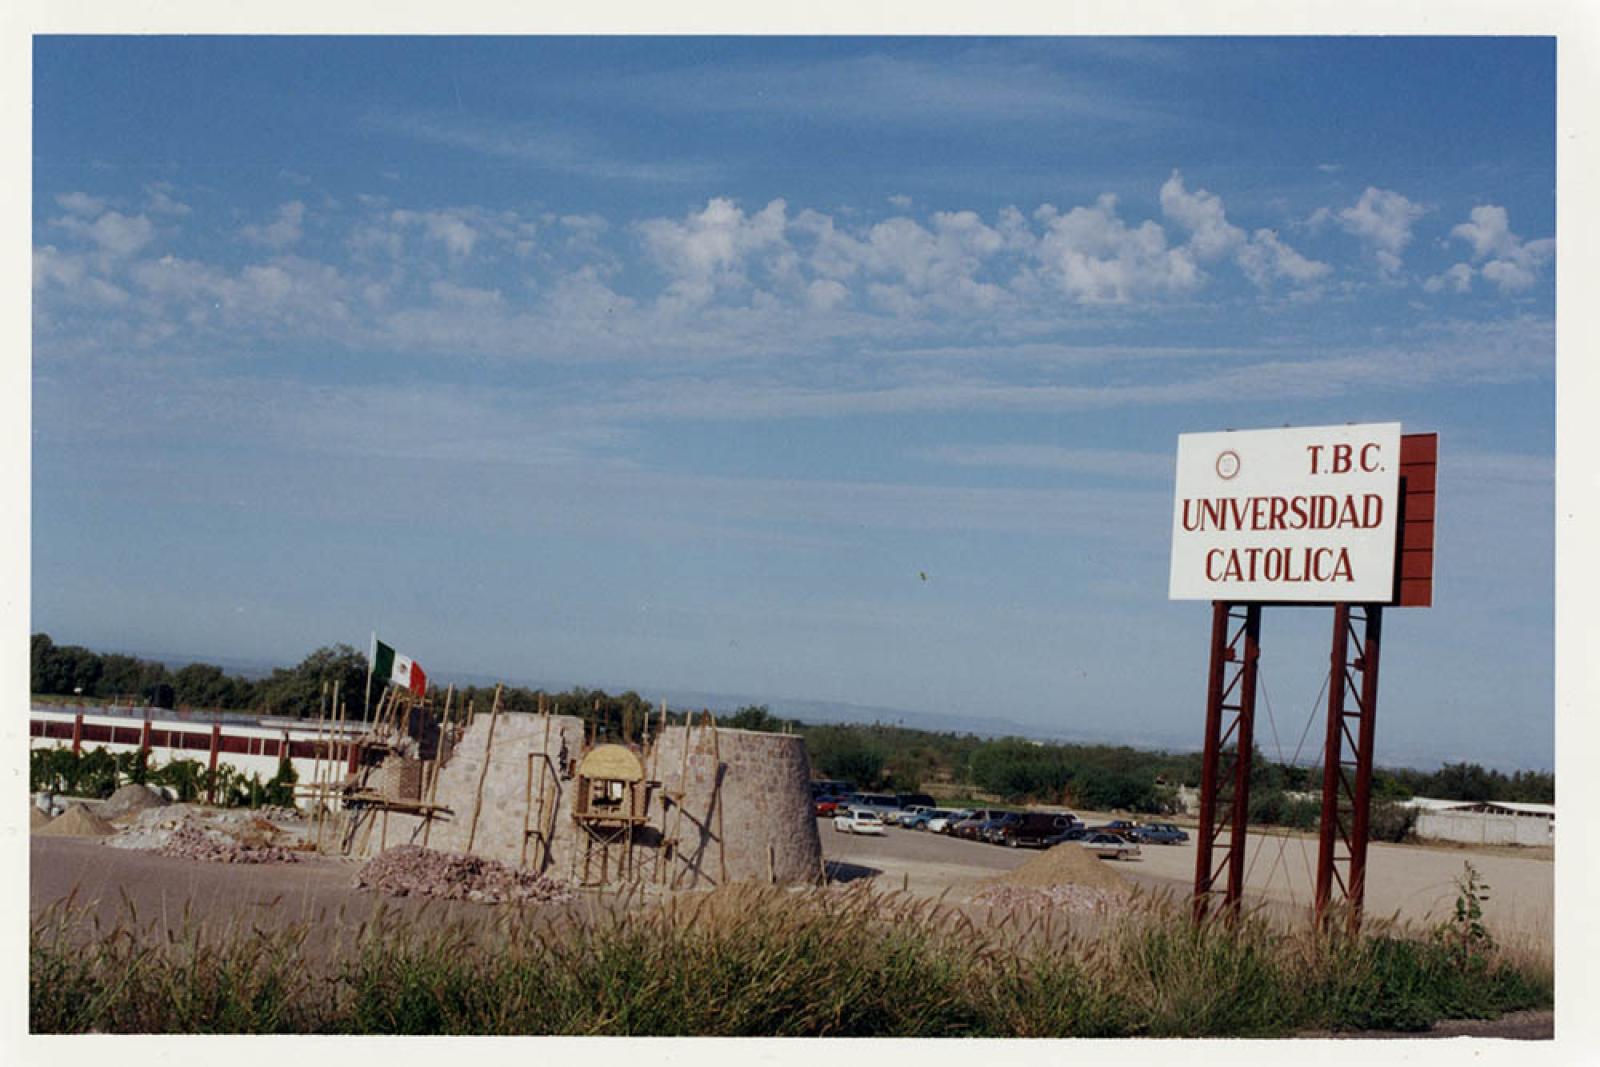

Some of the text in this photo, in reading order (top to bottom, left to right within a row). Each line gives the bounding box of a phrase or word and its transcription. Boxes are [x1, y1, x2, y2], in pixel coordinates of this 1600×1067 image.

[1307, 442, 1385, 475] T.B.C.
[1182, 493, 1383, 531] UNIVERSIDAD
[1205, 547, 1355, 582] CATOLICA
